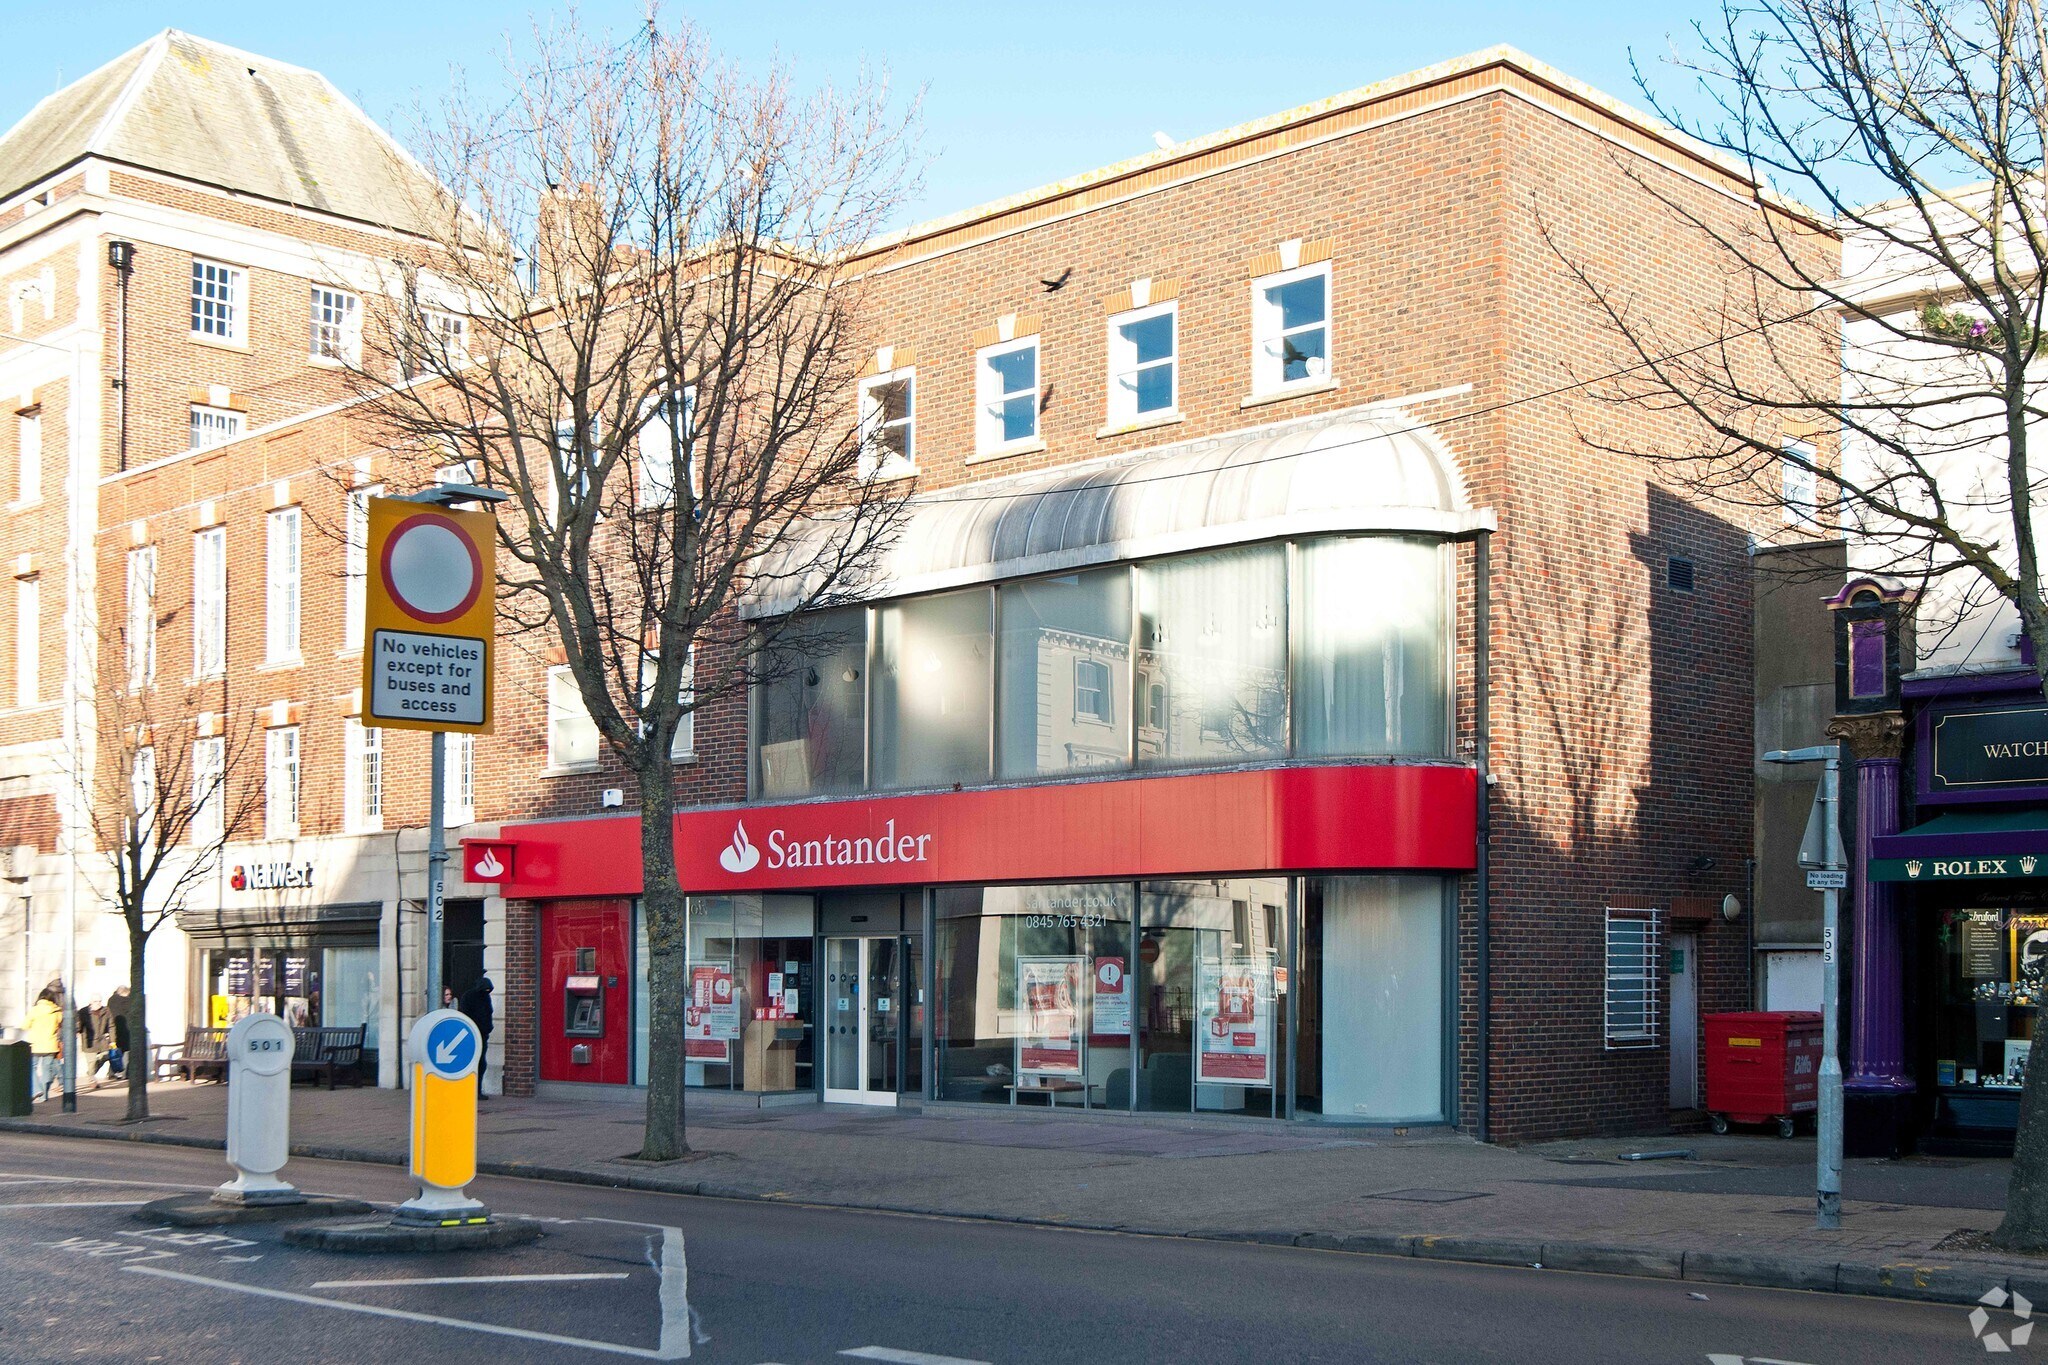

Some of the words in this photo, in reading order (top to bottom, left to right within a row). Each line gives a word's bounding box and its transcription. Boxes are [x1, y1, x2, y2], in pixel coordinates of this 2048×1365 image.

[383, 638, 407, 654] No
[412, 642, 479, 660] vehicles
[387, 660, 443, 677] except
[449, 664, 472, 678] for
[387, 676, 436, 693] buses
[441, 682, 471, 696] and
[401, 698, 457, 713] access
[767, 818, 932, 870] Santander
[247, 862, 314, 889] NatWest
[1933, 860, 2007, 876] ROLEX
[435, 881, 444, 921] 502
[1026, 893, 1117, 909] santander.co.uk
[1025, 915, 1054, 929] 0845
[1057, 915, 1077, 929] 765
[1080, 914, 1108, 928] 4321
[1824, 928, 1832, 962] 505
[249, 1039, 284, 1052] 501
